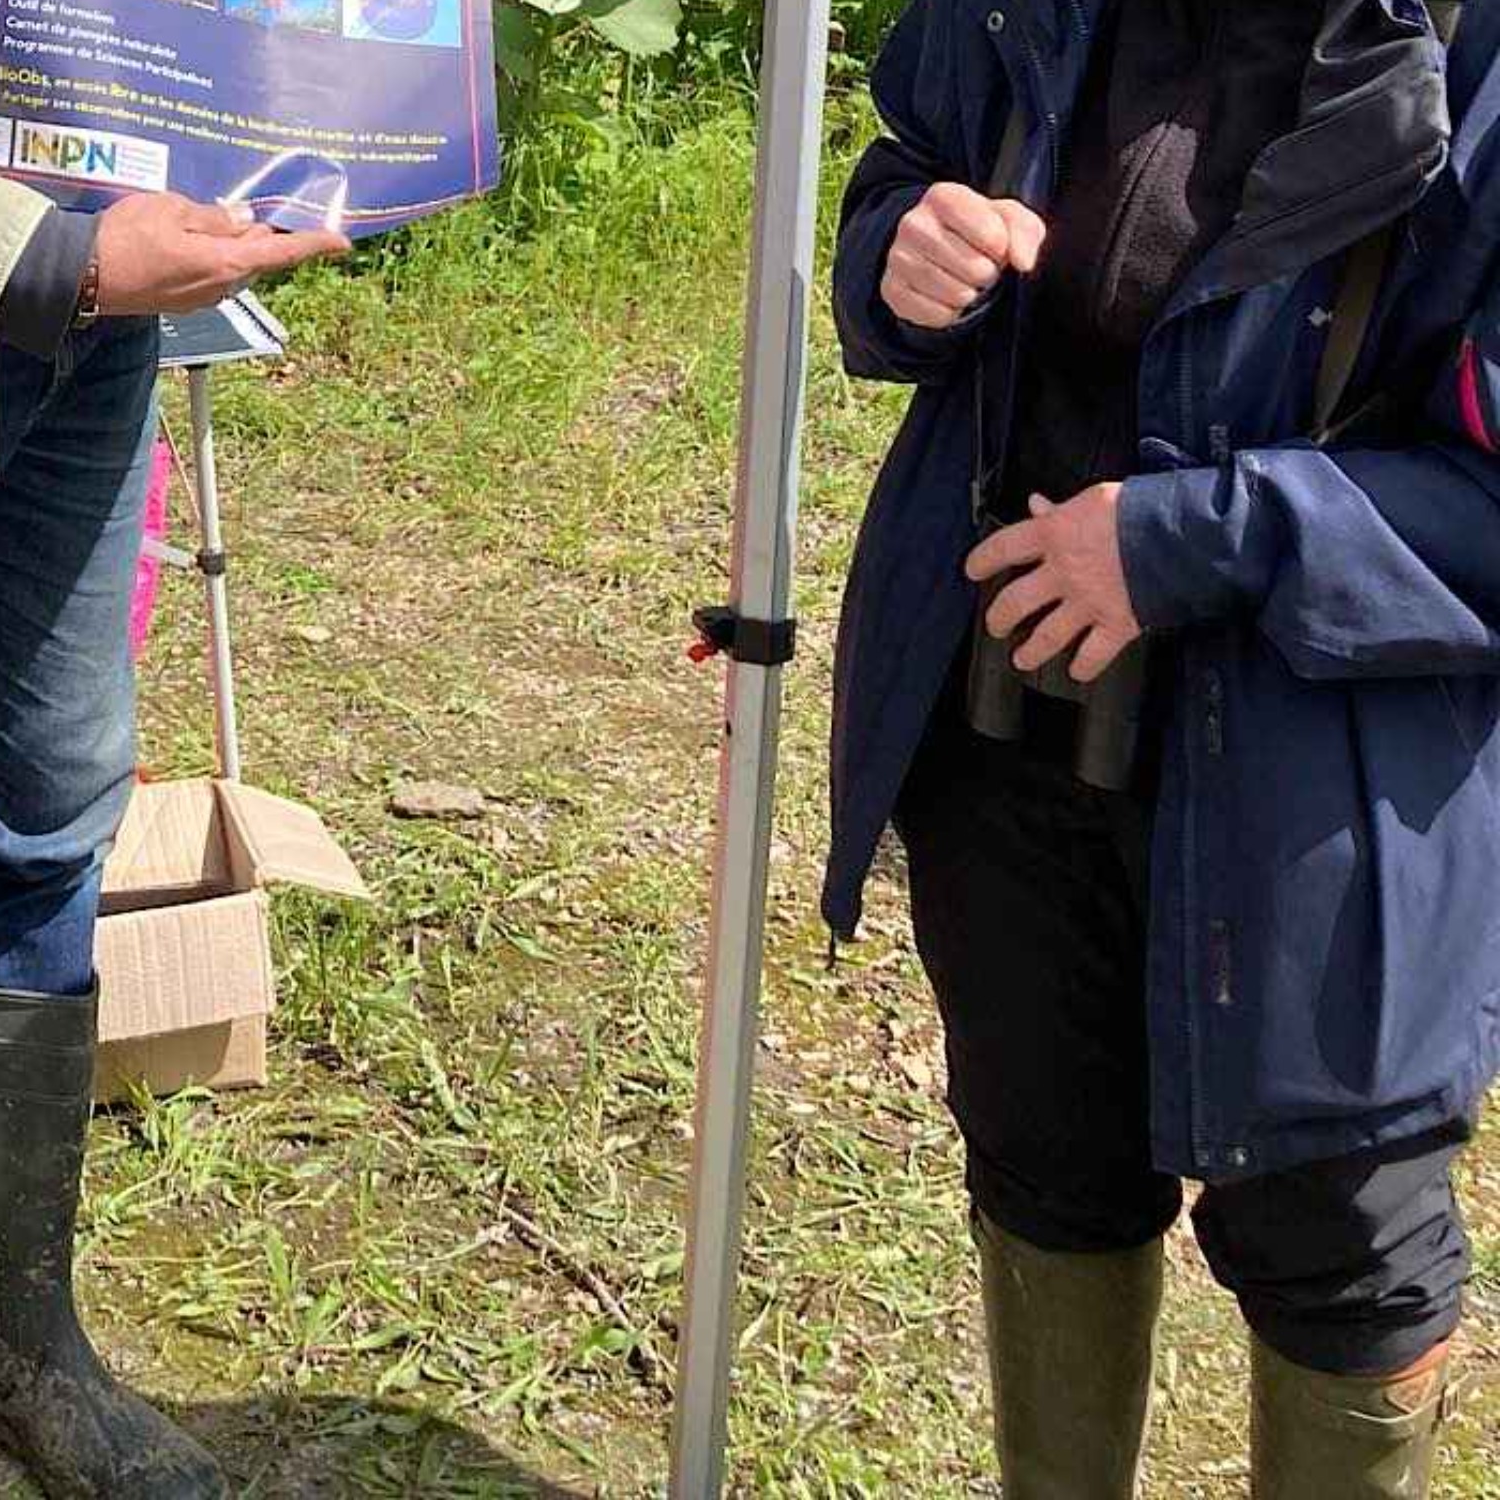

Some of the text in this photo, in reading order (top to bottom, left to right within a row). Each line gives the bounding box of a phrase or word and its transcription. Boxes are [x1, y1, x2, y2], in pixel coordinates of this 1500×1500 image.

[41, 1, 56, 13] de
[6, 16, 48, 33] Carnet
[51, 23, 67, 36] de
[4, 36, 75, 57] Programme
[77, 47, 93, 60] de
[20, 128, 117, 176] INPN
